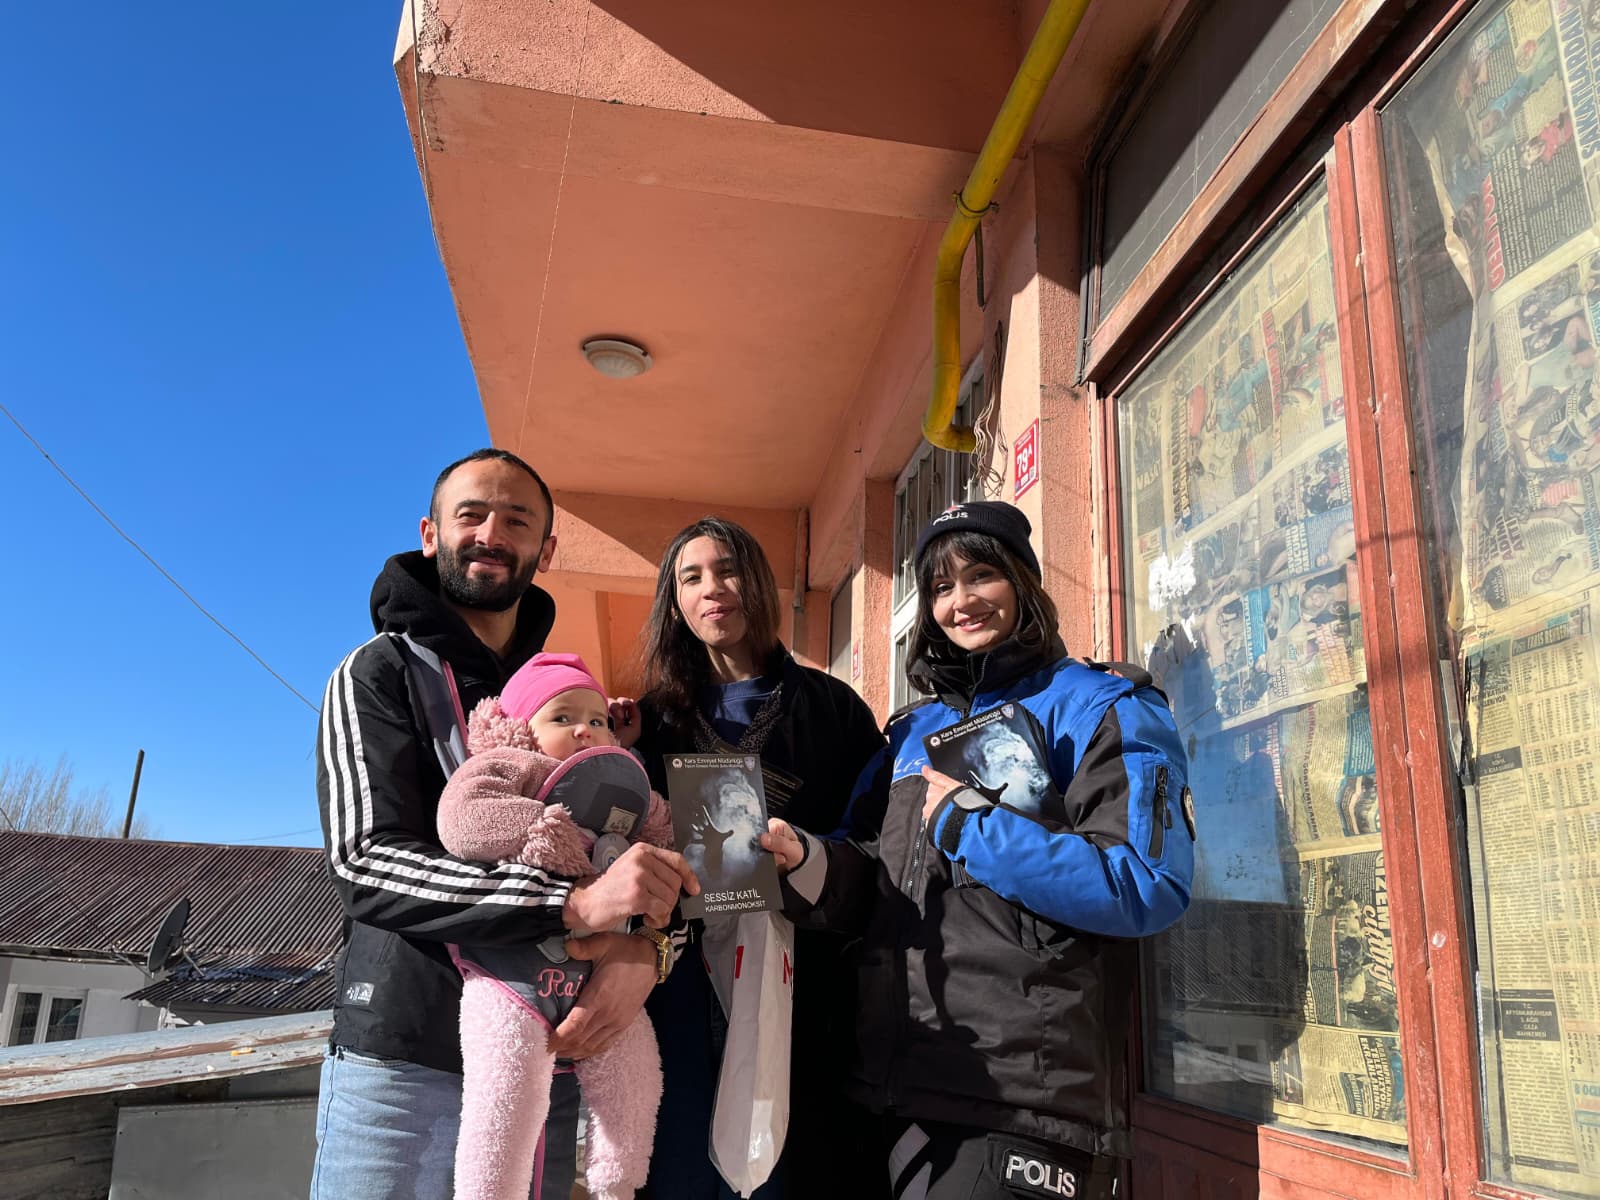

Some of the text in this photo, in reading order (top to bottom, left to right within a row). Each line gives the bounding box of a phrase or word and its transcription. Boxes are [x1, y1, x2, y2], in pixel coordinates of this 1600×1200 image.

[1559, 5, 1600, 159] SAKATLARDAN
[940, 710, 1001, 739] Kars Emniyet Müdürlüğü
[718, 757, 743, 765] Müdürlüğü
[704, 887, 761, 903] SESSİZ KATİL
[1359, 1037, 1381, 1117] EKRANLARINDA
[1370, 1047, 1386, 1109] TELEVİZYON
